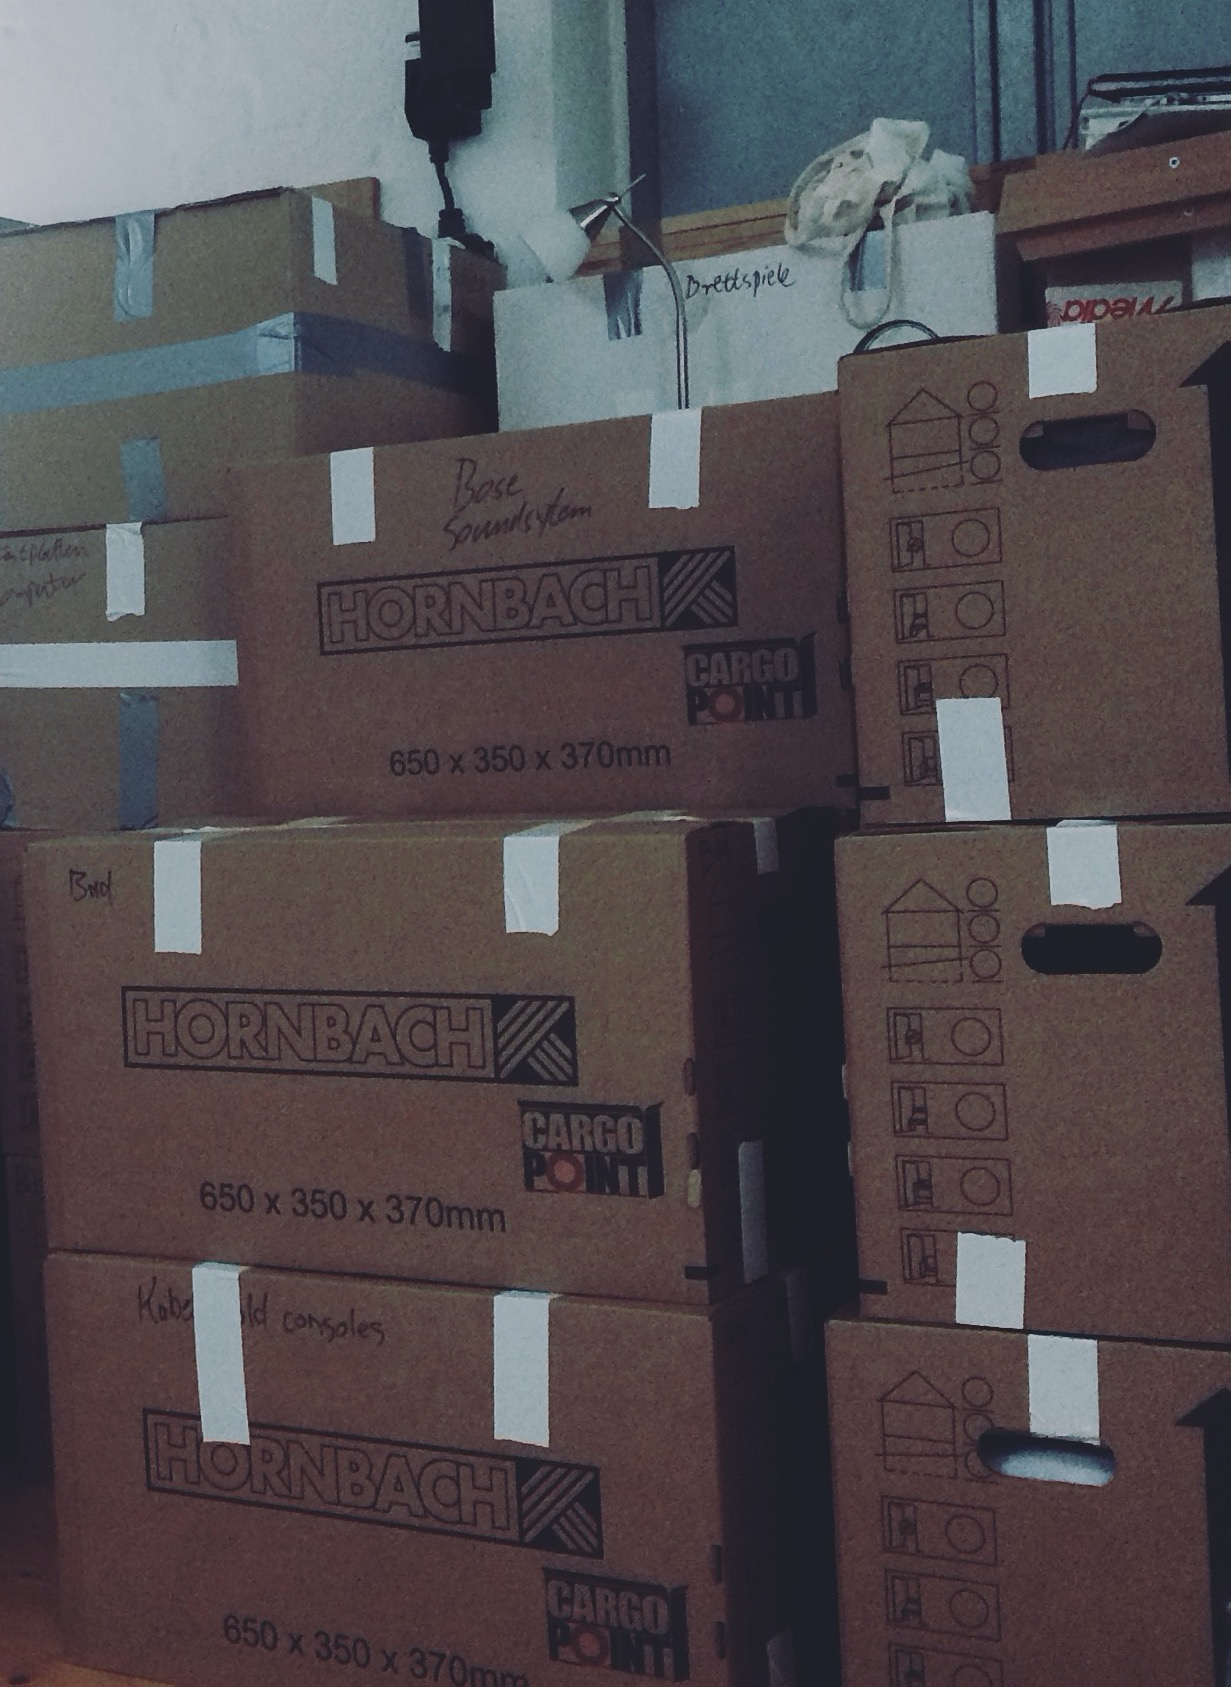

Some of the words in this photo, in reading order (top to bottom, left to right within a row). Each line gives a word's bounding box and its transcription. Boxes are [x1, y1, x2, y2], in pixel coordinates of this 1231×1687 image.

[453, 457, 523, 512] Bose
[325, 563, 657, 646] HORNBACH
[684, 646, 800, 688] CARGO
[686, 684, 803, 724] POINT
[388, 747, 441, 777] 650
[450, 754, 465, 774] x
[474, 745, 526, 774] 350
[535, 750, 551, 771] x
[560, 740, 673, 770] 370mm
[131, 997, 489, 1070] HORNBACH
[522, 1110, 644, 1153] CARGO
[524, 1149, 647, 1197] POINT
[199, 1181, 255, 1213] 650
[265, 1193, 282, 1215] x
[291, 1187, 347, 1219] 350
[358, 1201, 375, 1224] x
[385, 1193, 507, 1234] 370mm
[282, 1307, 386, 1347] consoles
[153, 1418, 514, 1532] HORNBACH
[545, 1579, 669, 1636] CARGO
[224, 1612, 278, 1654] 650
[287, 1631, 304, 1655] x
[315, 1628, 370, 1671] 350
[382, 1649, 400, 1673] x
[409, 1646, 529, 1687] 370mm
[547, 1618, 674, 1681] POINT
